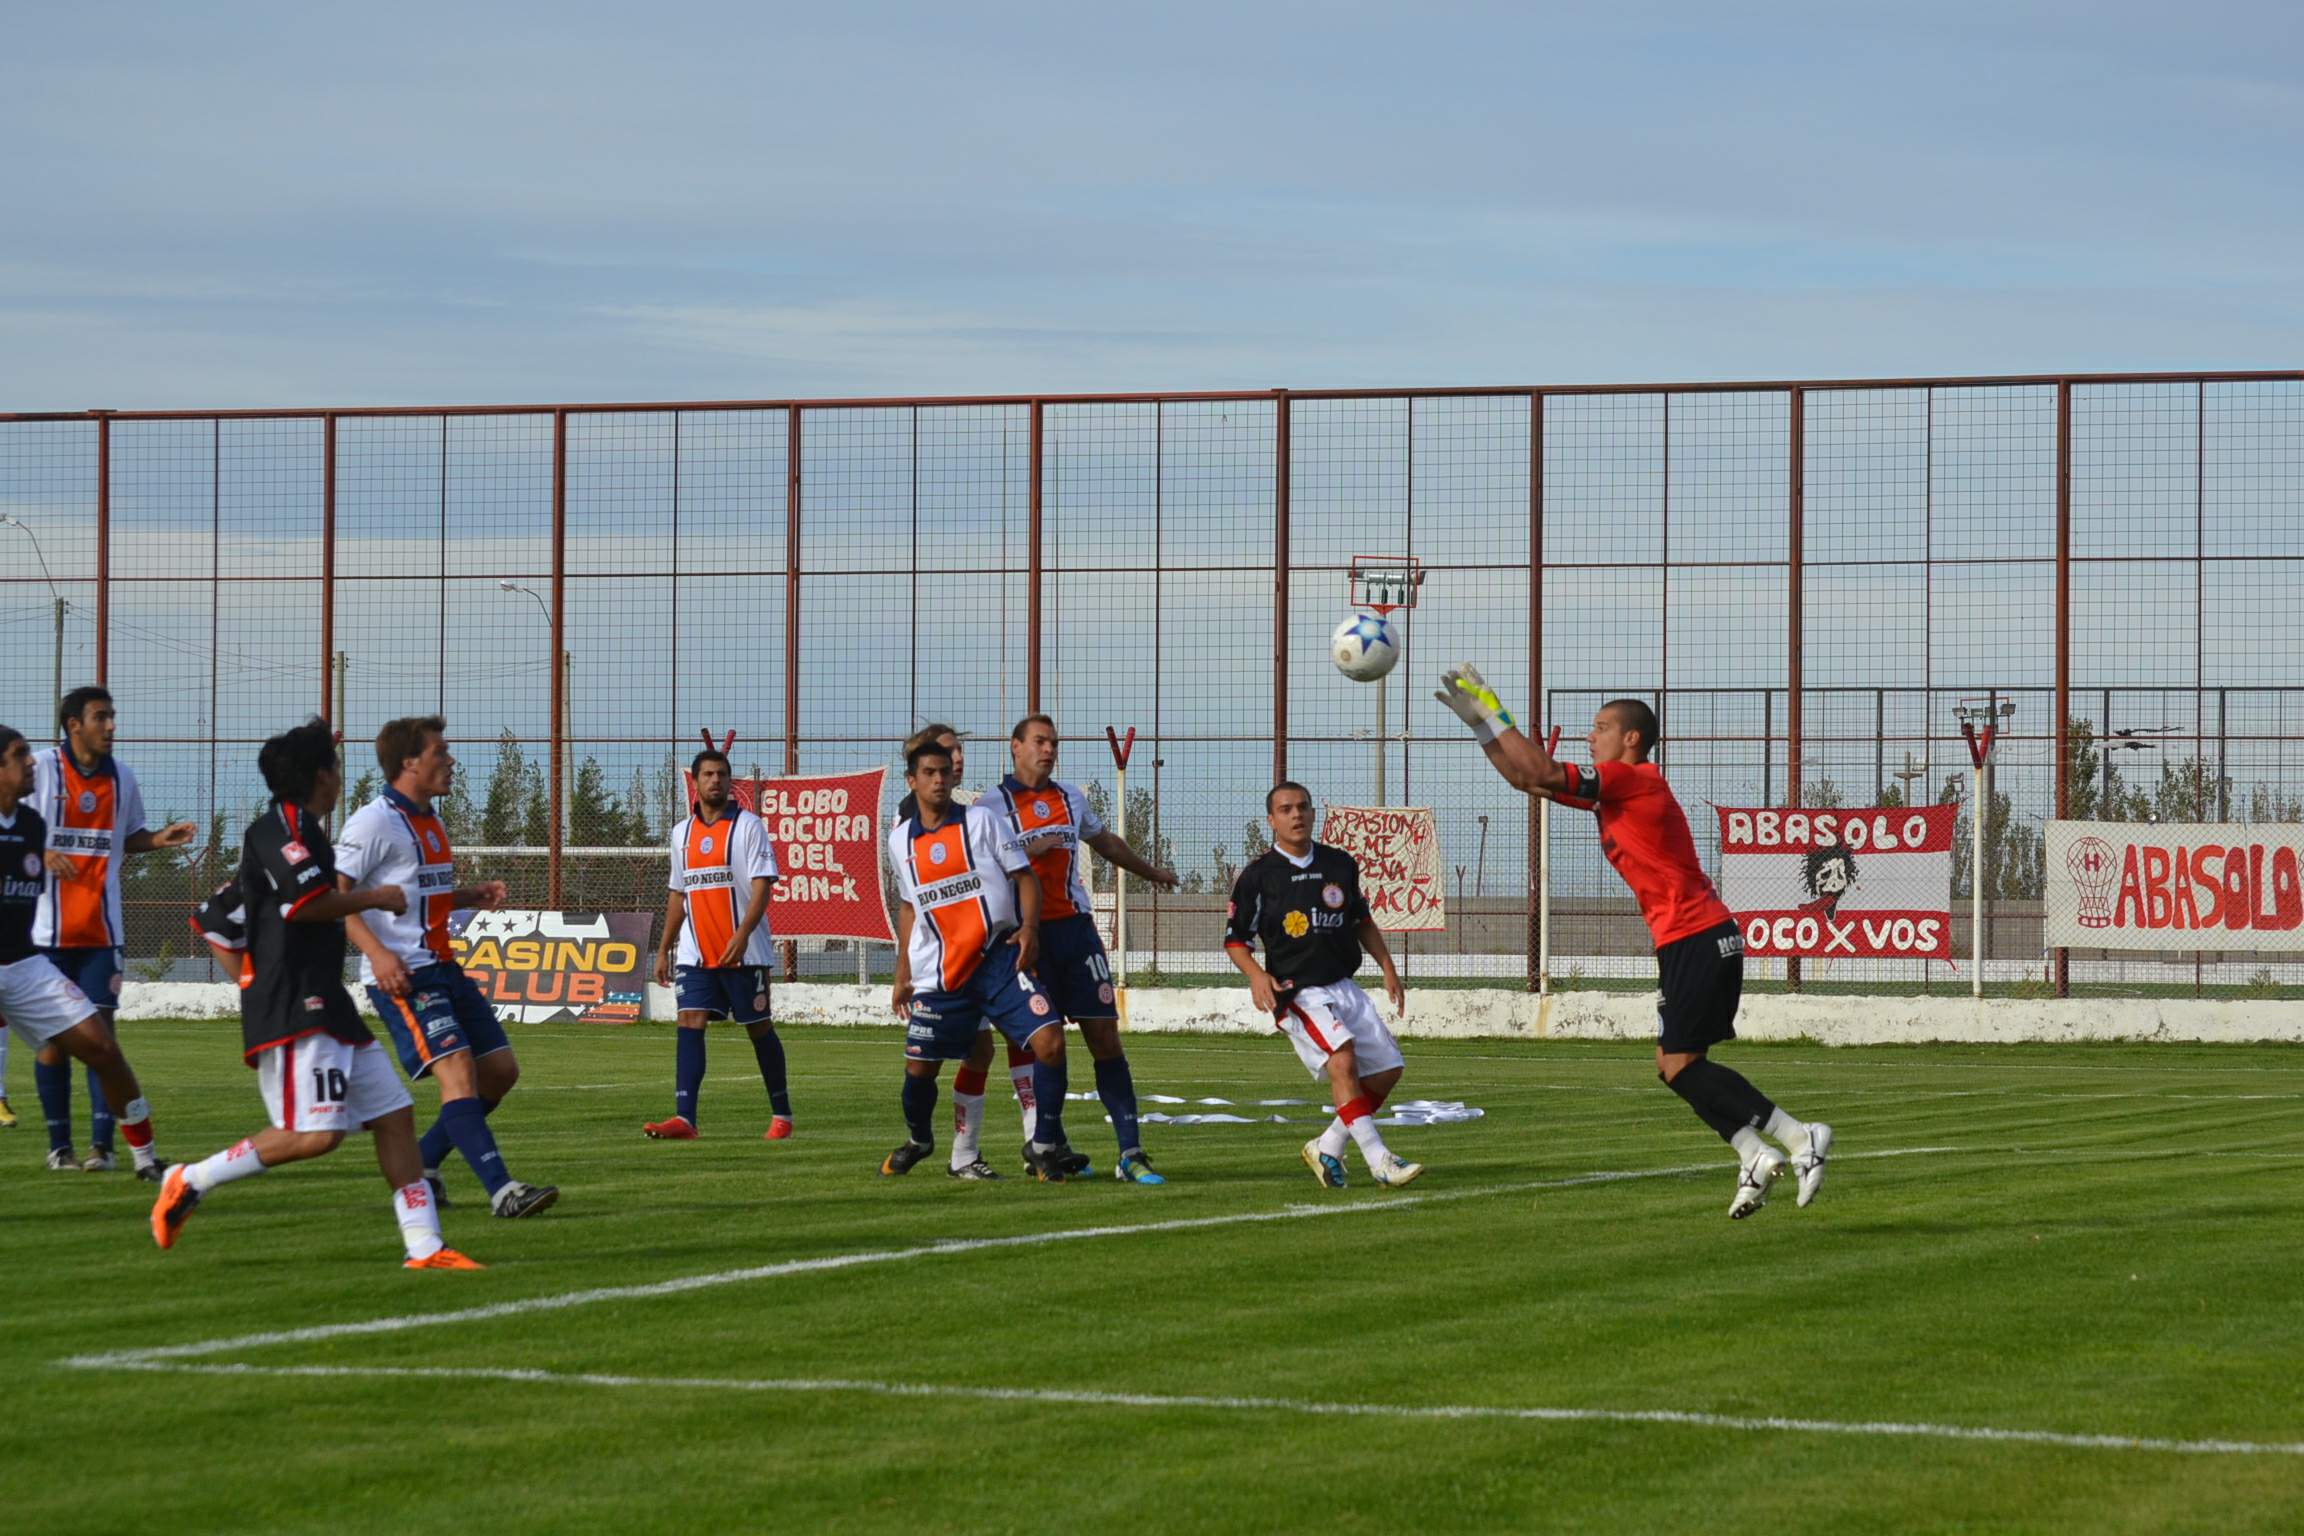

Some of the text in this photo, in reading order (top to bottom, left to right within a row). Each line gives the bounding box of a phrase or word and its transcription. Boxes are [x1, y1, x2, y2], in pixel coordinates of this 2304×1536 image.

[761, 789, 848, 815] GLOBO
[1728, 811, 1926, 849] ABASOLO
[788, 843, 843, 872] DEL
[701, 872, 734, 884] NEGRO
[773, 875, 860, 902] SAN-K
[917, 876, 982, 906] RIO NEGRO
[2113, 843, 2303, 930] ABASOLO
[1733, 917, 1819, 950] OCO
[1862, 918, 1940, 951] VOS
[1017, 970, 1036, 993] 4
[1085, 953, 1109, 982] 10
[313, 1067, 348, 1103] 10
